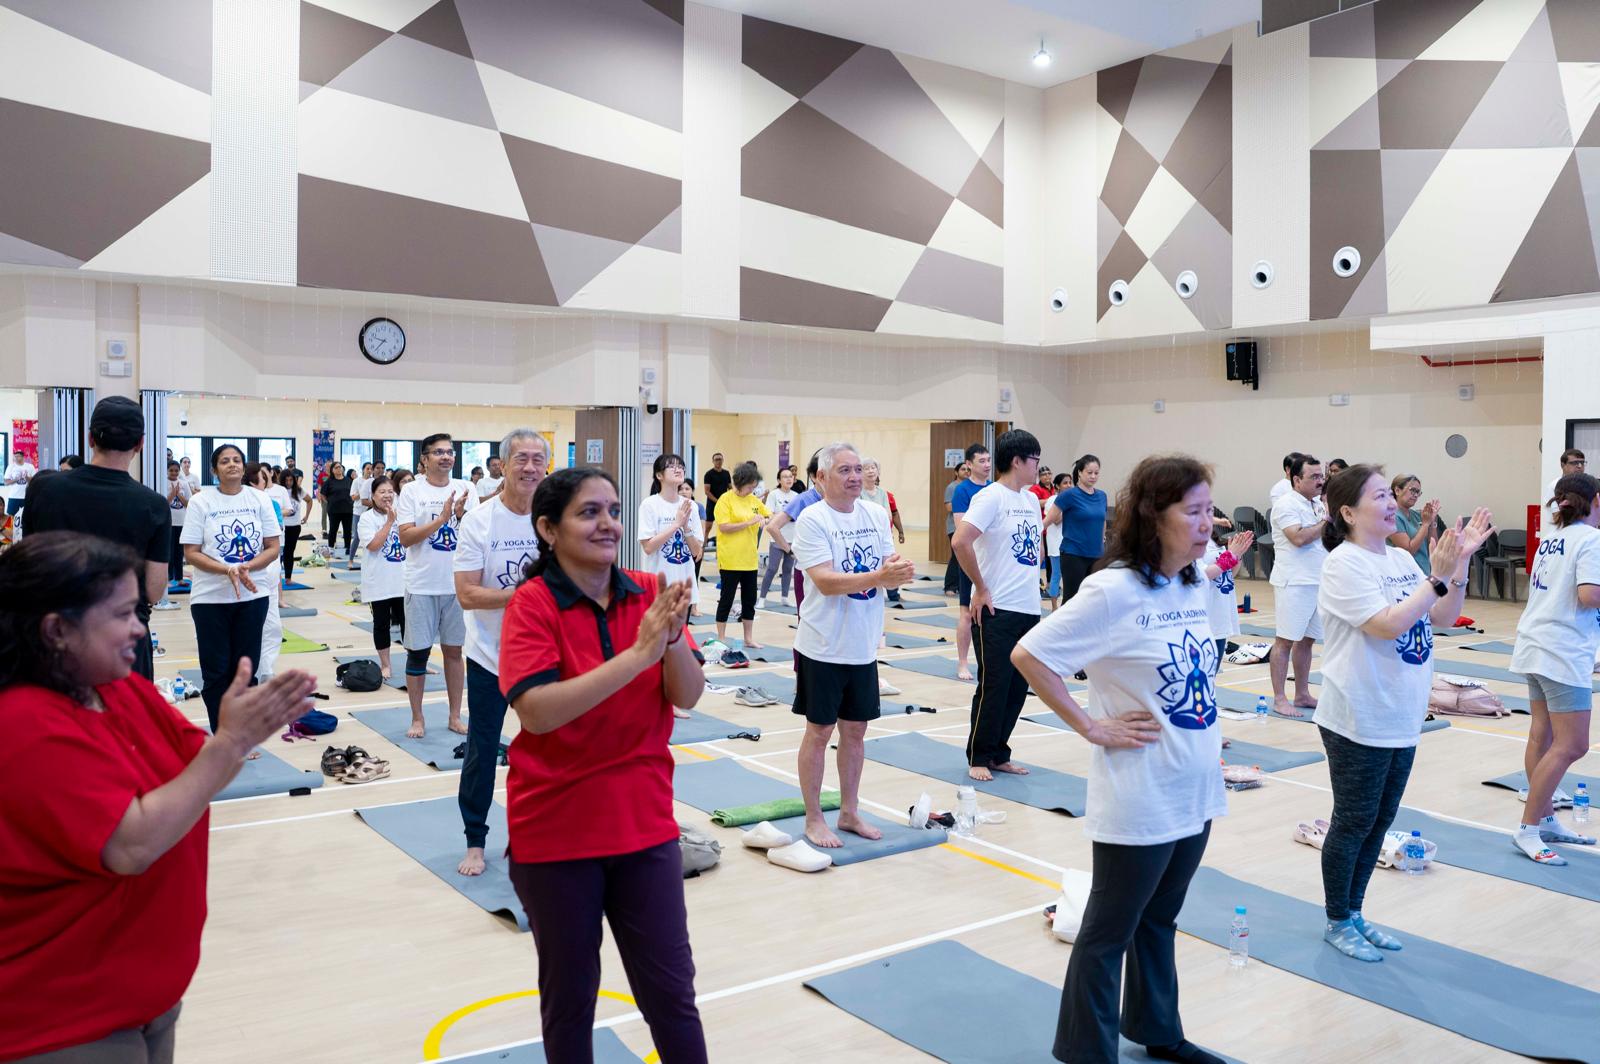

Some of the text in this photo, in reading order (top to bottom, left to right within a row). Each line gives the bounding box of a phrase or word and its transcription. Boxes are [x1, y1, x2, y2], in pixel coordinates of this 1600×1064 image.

[503, 539, 525, 547] YOGA
[1538, 538, 1565, 556] OGA
[1156, 610, 1182, 622] YOGA
